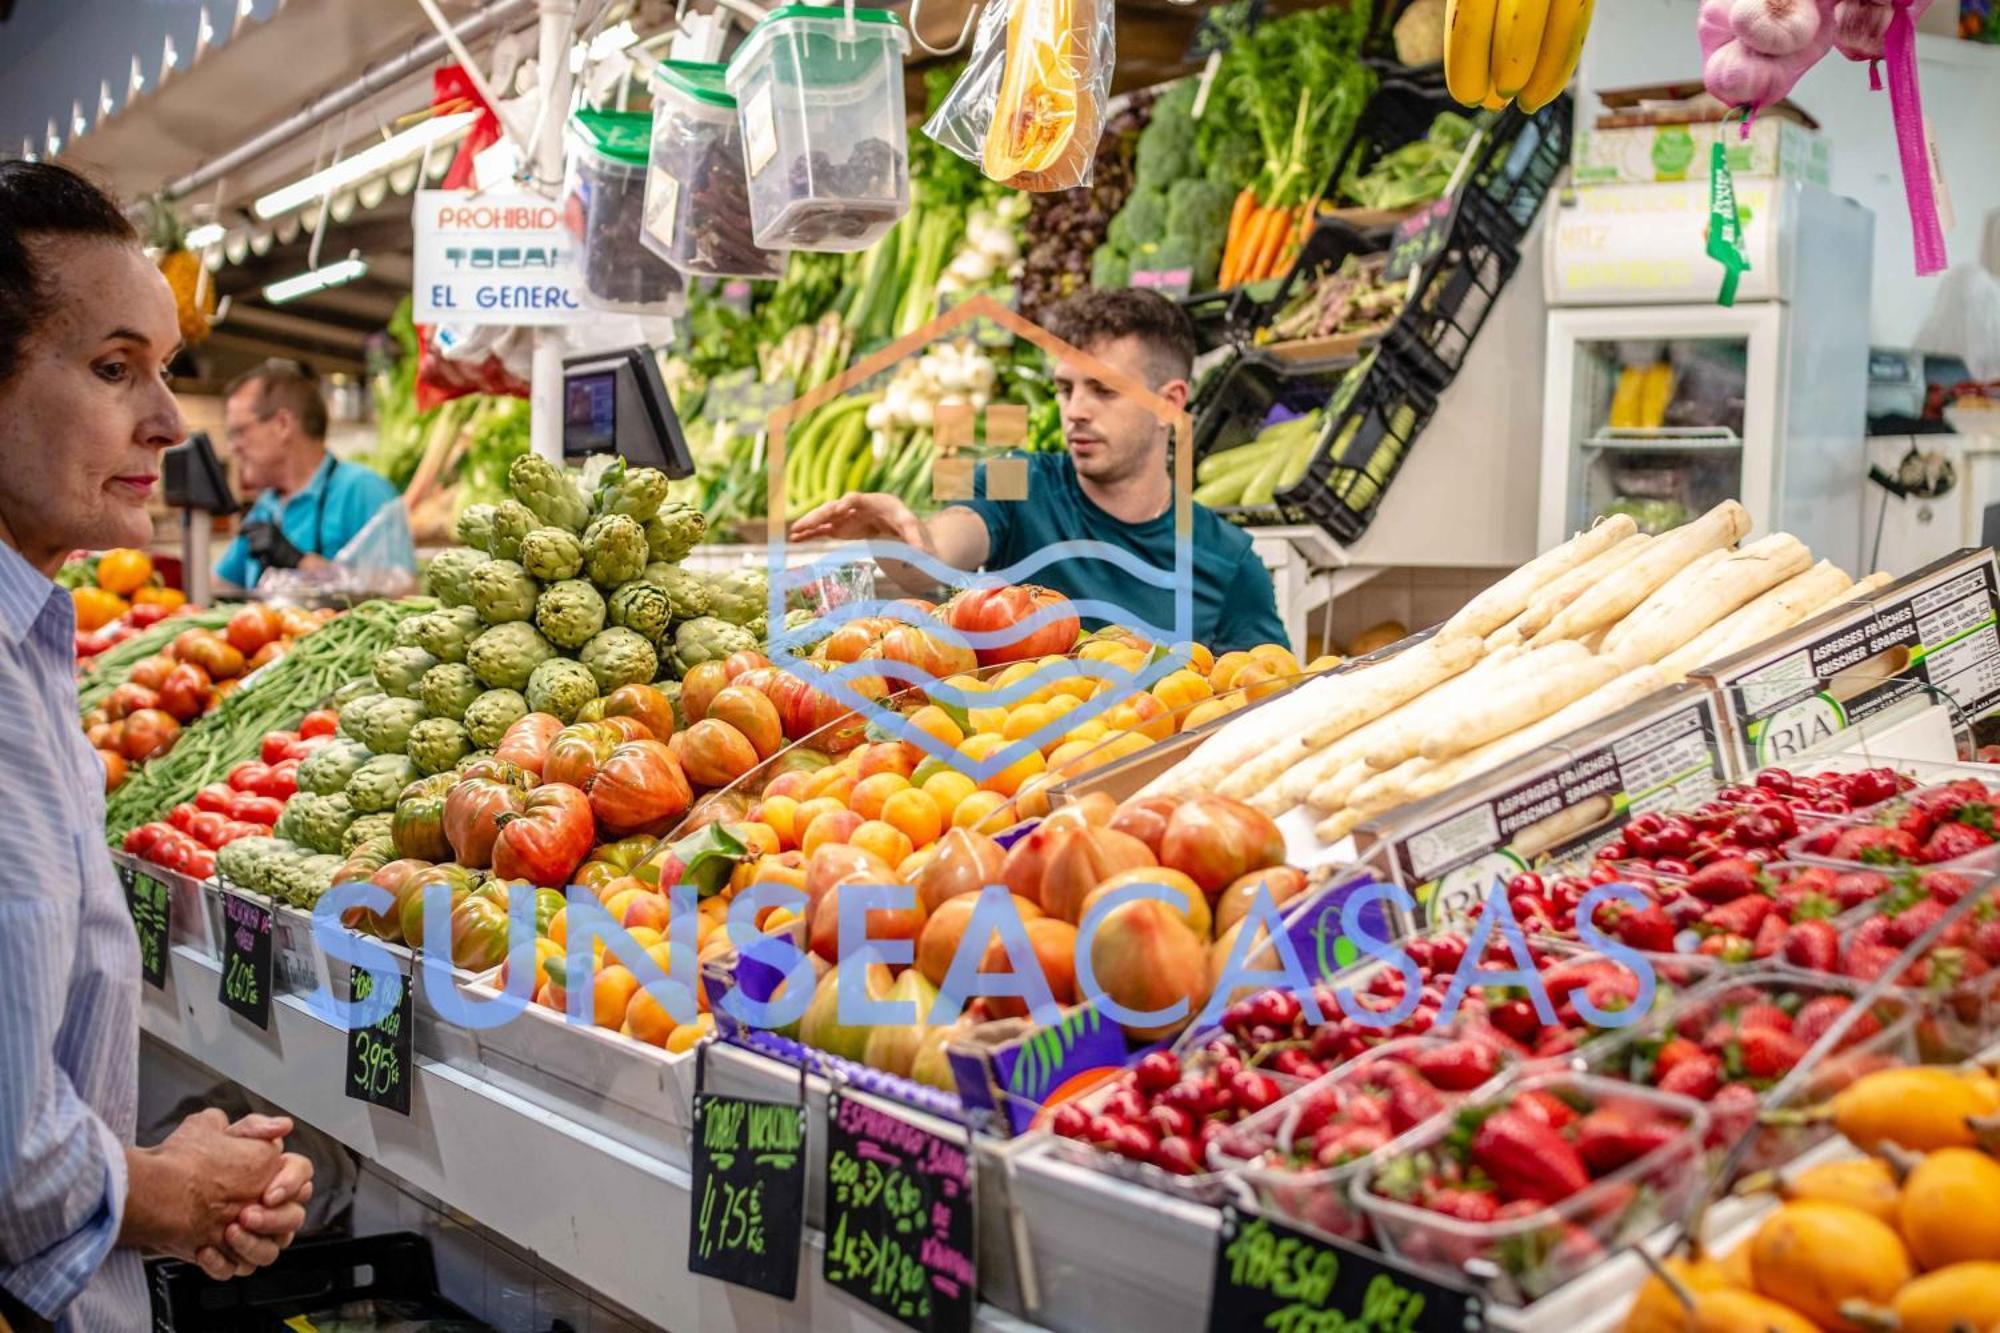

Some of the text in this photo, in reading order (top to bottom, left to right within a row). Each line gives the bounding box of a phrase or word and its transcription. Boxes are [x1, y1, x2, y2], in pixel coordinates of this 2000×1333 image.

[438, 207, 563, 230] PROHIBID
[432, 285, 456, 308] EL
[1812, 629, 1865, 662] ASPERGES
[1816, 624, 1917, 677] FRISCHER SPARGEL
[1769, 713, 1833, 760] RIA
